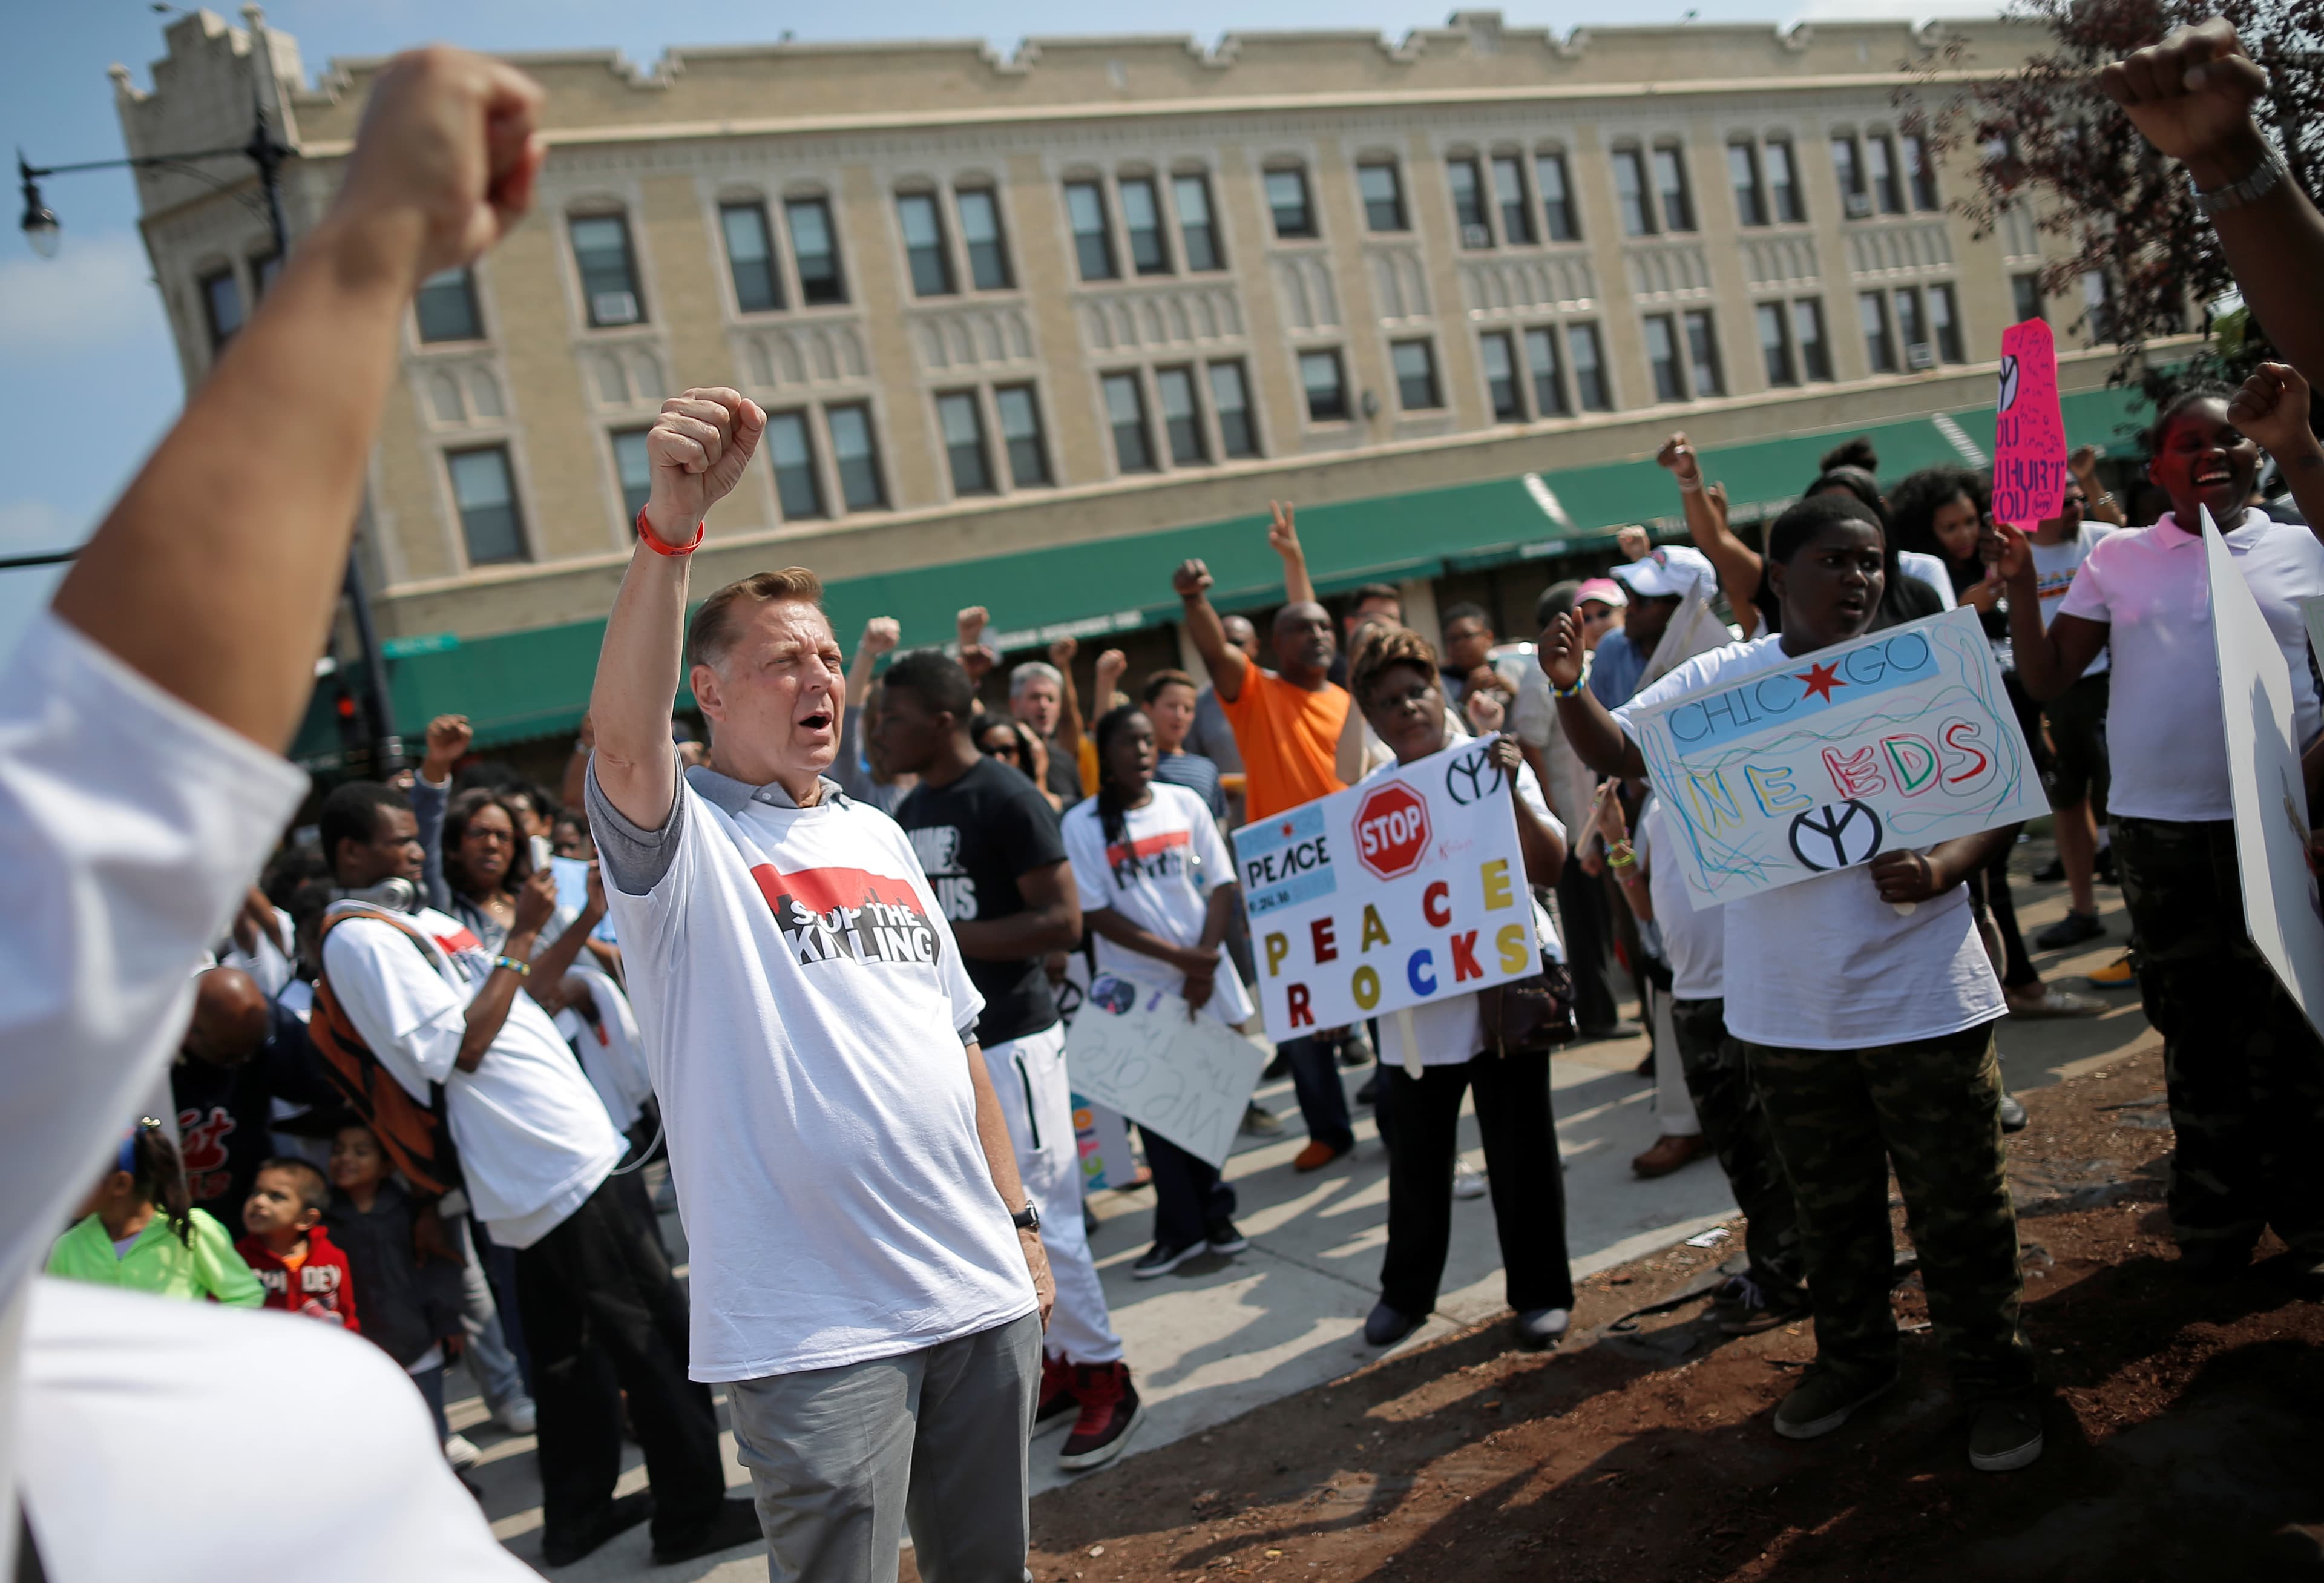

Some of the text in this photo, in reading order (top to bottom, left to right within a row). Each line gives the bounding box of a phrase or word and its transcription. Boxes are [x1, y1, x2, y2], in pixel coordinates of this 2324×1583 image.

[2005, 458, 2065, 493] HURT
[1669, 632, 1928, 742] CHICGO
[1361, 805, 1422, 856] STOP
[1247, 836, 1331, 889] PEACE
[789, 899, 922, 933] SOP THE
[1264, 858, 1513, 978] PEACE
[783, 924, 933, 966] KILING
[1287, 923, 1529, 1028] ROCKS
